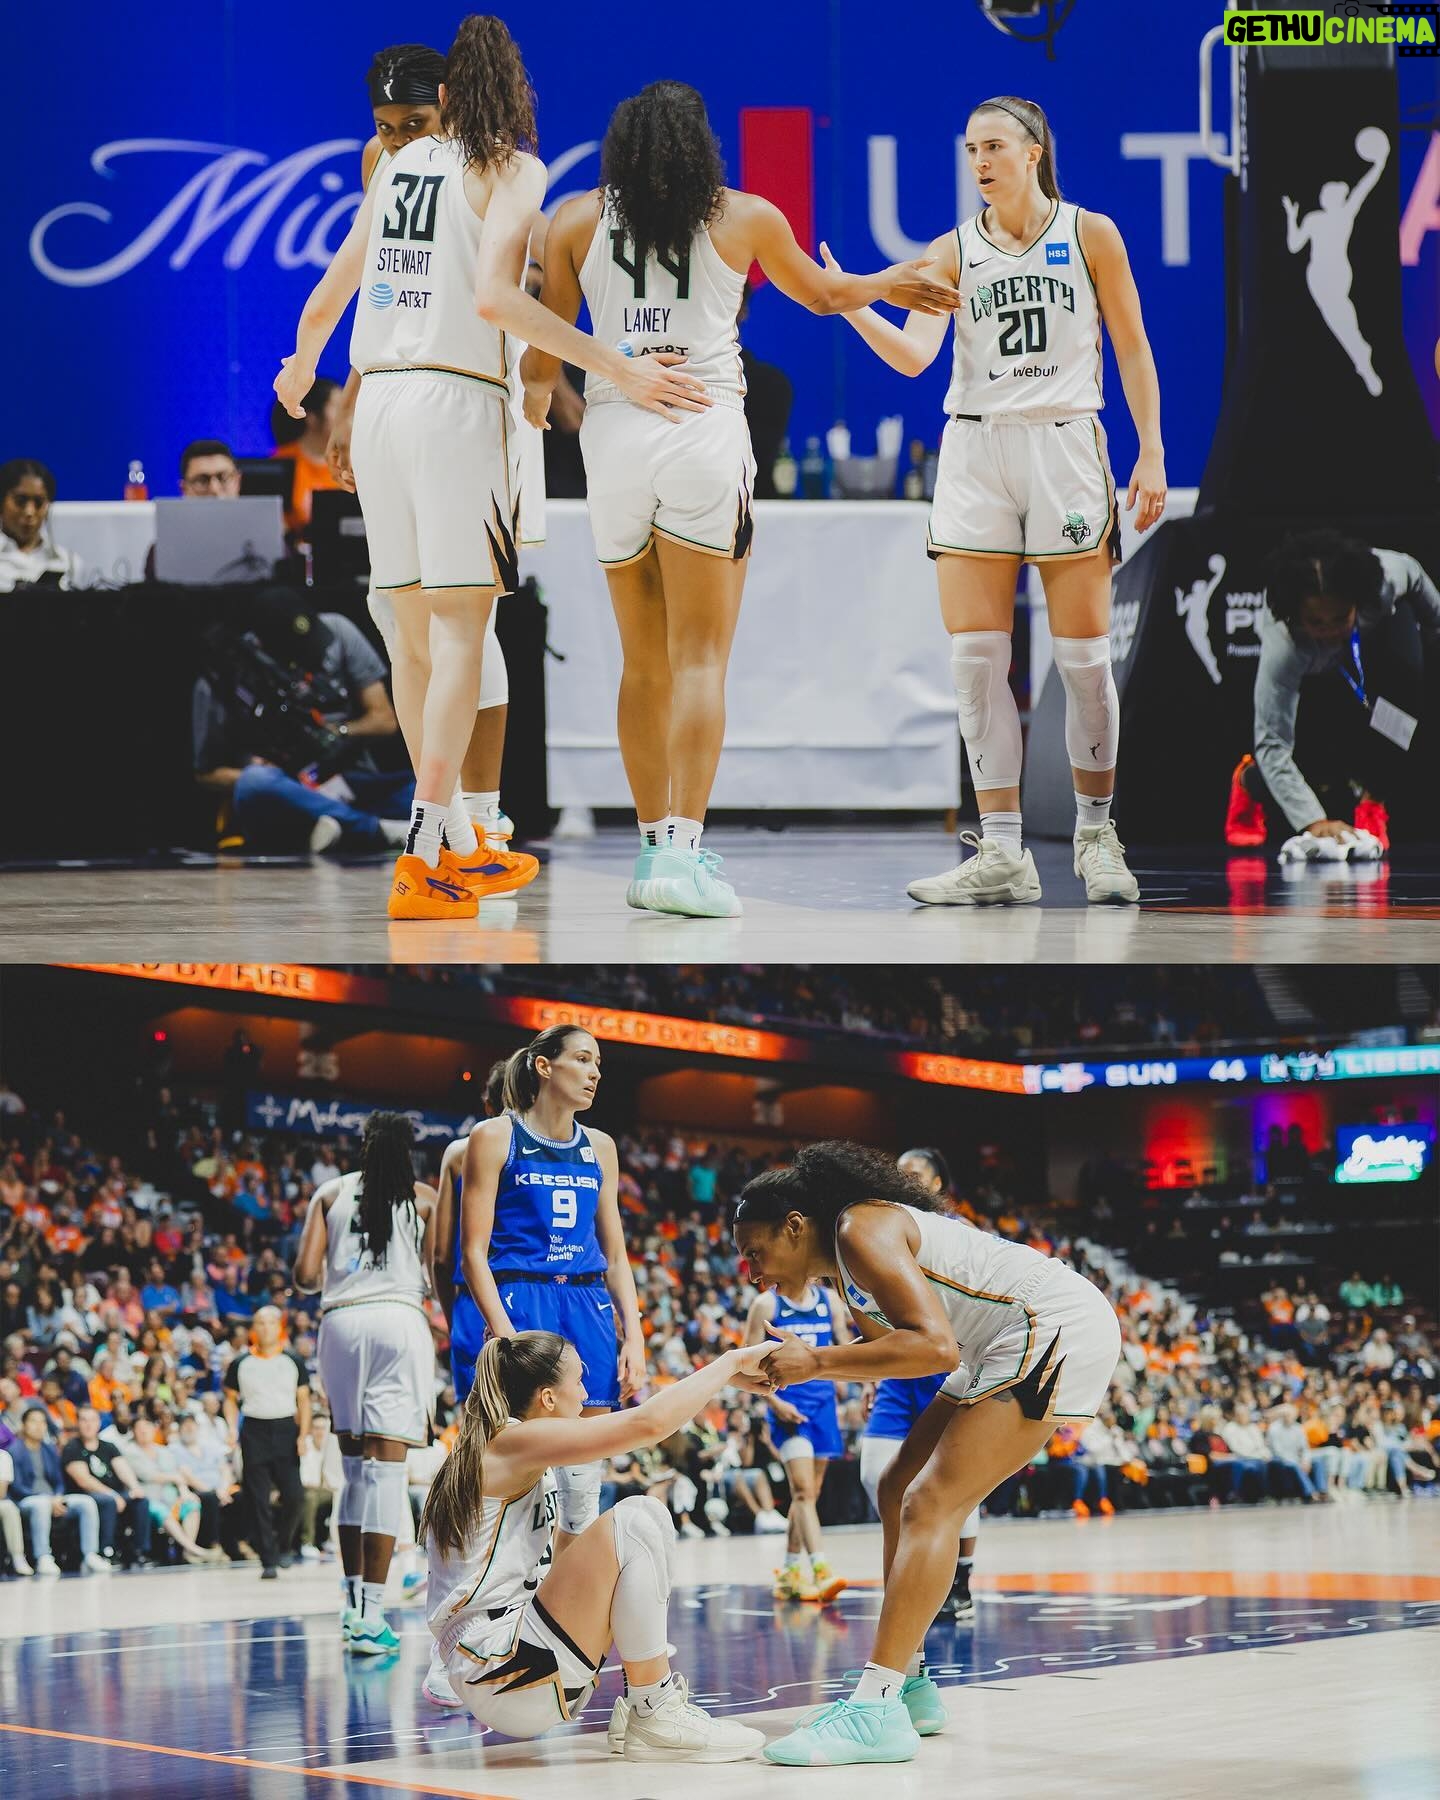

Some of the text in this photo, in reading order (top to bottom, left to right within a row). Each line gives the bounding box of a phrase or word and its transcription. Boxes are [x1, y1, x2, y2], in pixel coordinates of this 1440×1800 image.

[382, 173, 446, 242] 30
[377, 247, 432, 276] STEWART
[609, 228, 690, 300] 44
[1048, 250, 1067, 258] HSS
[396, 290, 432, 309] AT&T
[624, 307, 671, 333] LANEY
[997, 306, 1047, 357] 20
[1013, 365, 1059, 378] Webull
[1226, 592, 1262, 607] WN
[237, 965, 313, 989] FIRE
[540, 1007, 649, 1037] FORCED
[1105, 1062, 1176, 1087] SUN
[1208, 1059, 1248, 1082] 44
[514, 1172, 599, 1191] KEESUSK
[552, 1189, 577, 1228] 9
[549, 1234, 563, 1243] Yale
[546, 1252, 573, 1261] Health
